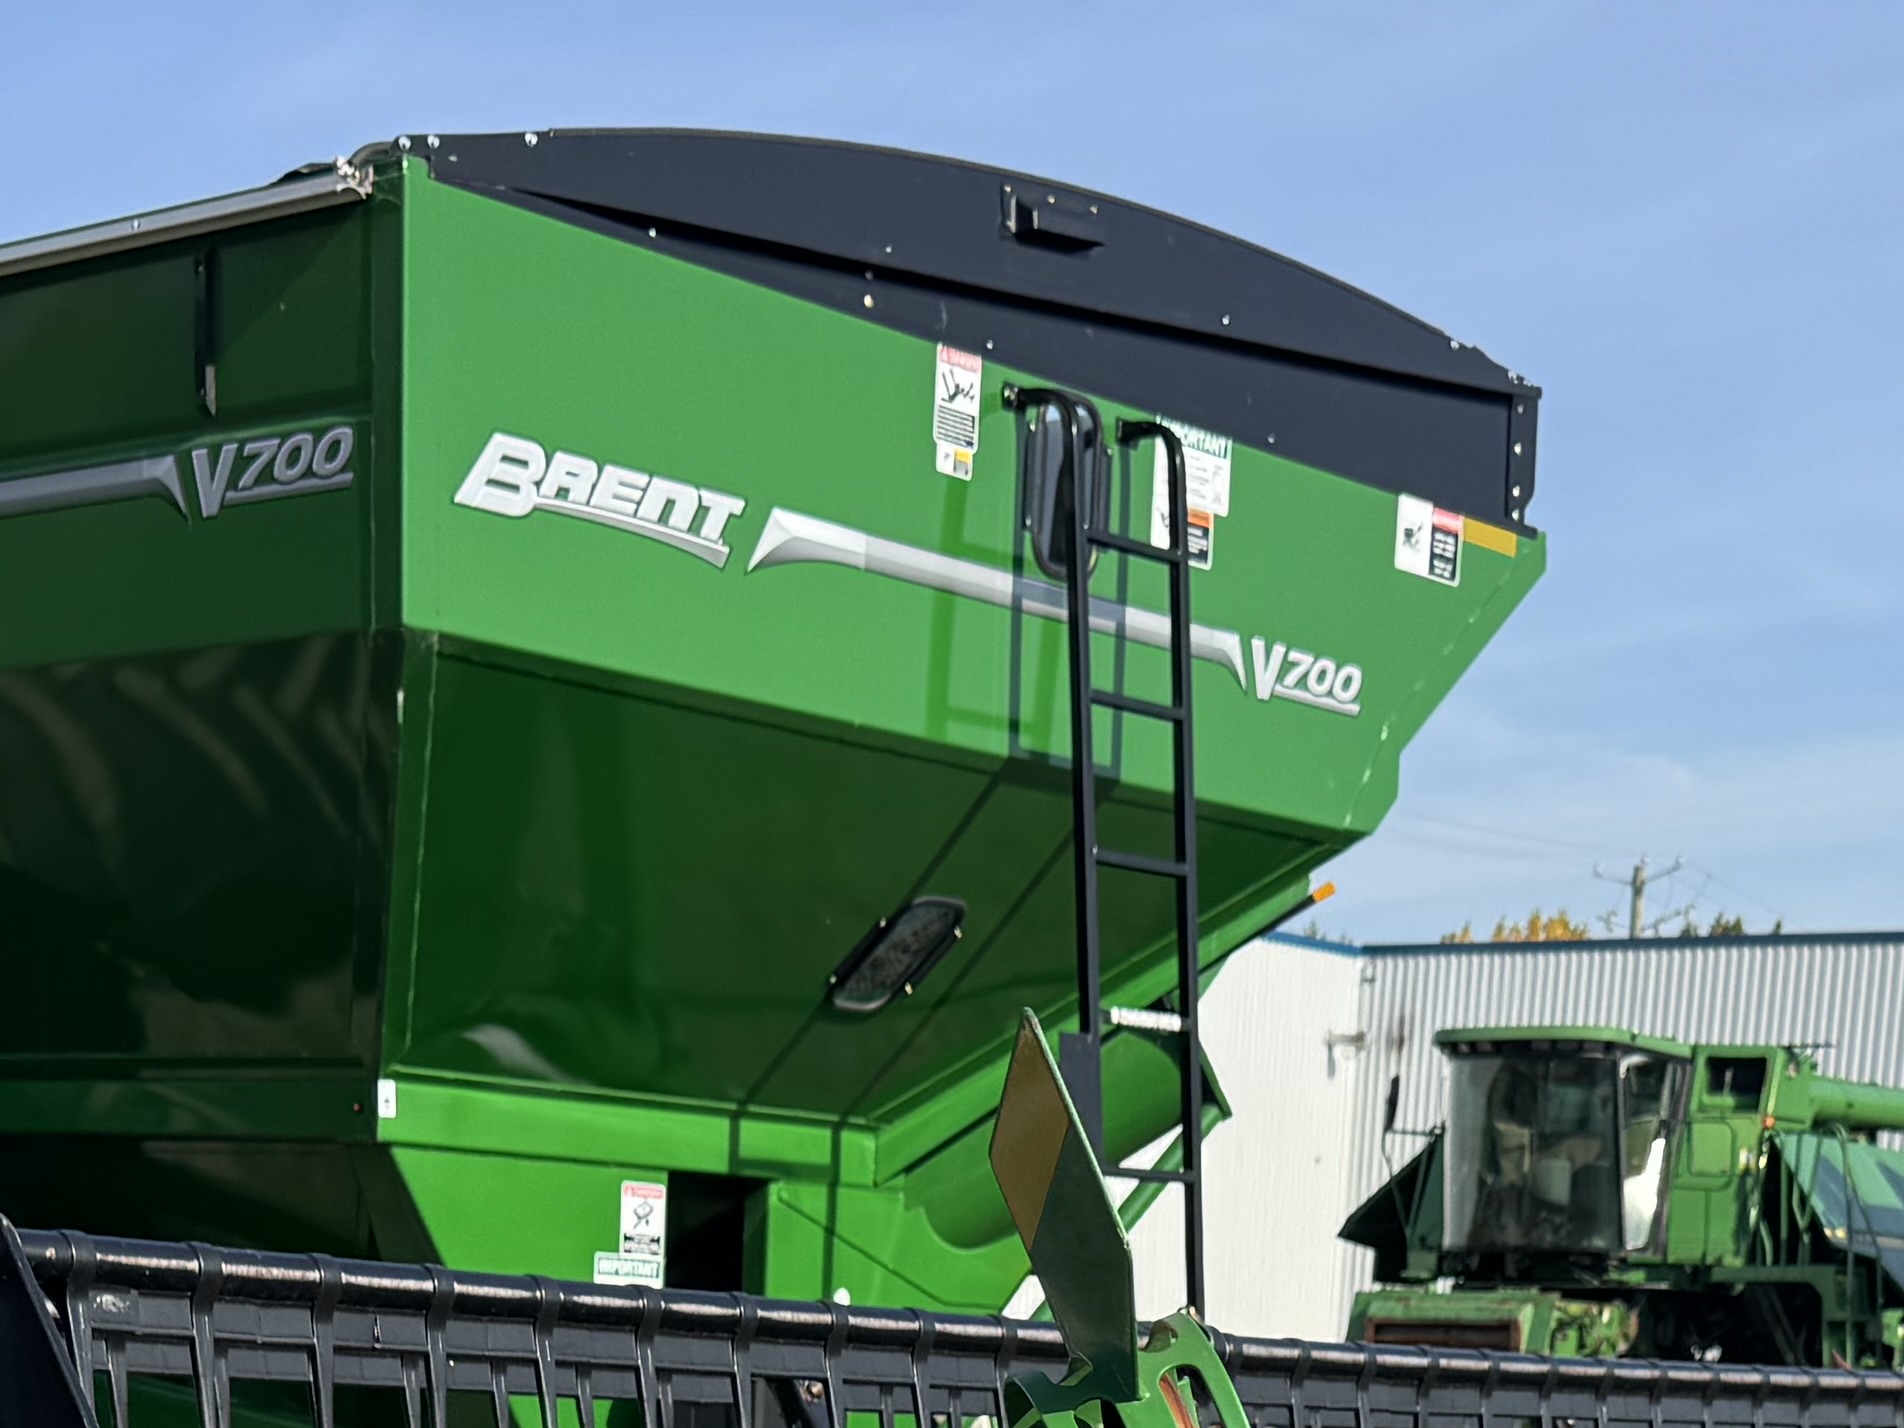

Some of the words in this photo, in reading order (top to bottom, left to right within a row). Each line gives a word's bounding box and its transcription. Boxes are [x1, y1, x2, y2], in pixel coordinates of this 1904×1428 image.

[192, 422, 353, 518] V700
[454, 432, 745, 550] BRENT
[1251, 634, 1362, 704] V700
